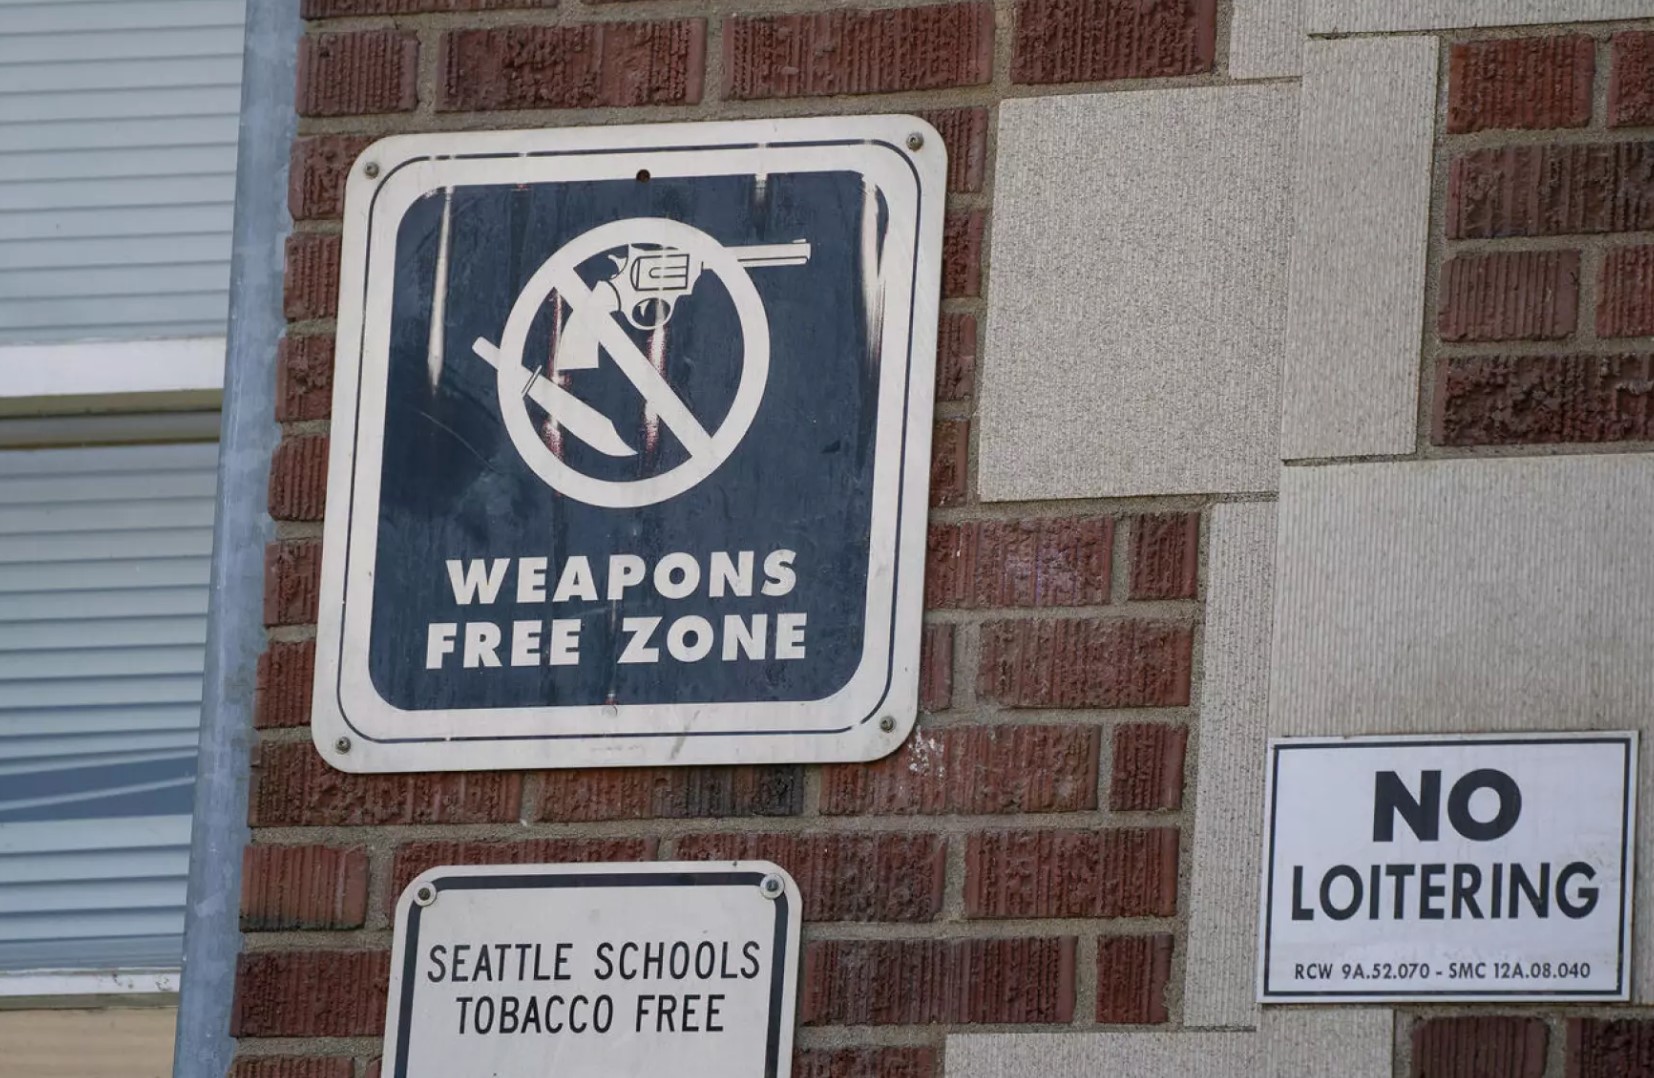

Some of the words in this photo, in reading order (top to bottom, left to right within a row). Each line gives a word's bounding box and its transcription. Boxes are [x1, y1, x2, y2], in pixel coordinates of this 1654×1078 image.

[446, 549, 797, 605] WEAPONS
[425, 618, 582, 669] FREE
[617, 612, 808, 664] ZONE
[1373, 768, 1522, 842] NO
[1291, 861, 1600, 921] LOITERING
[427, 943, 573, 982] SEATTLE
[594, 940, 760, 980] SCHOOLS
[1294, 963, 1333, 980] RCW
[1341, 962, 1430, 980] 9A.52.070
[1448, 962, 1486, 979] SMC
[1493, 961, 1591, 979] 12A.08.040
[455, 994, 614, 1035] TOBACCO
[635, 993, 726, 1033] FREE
